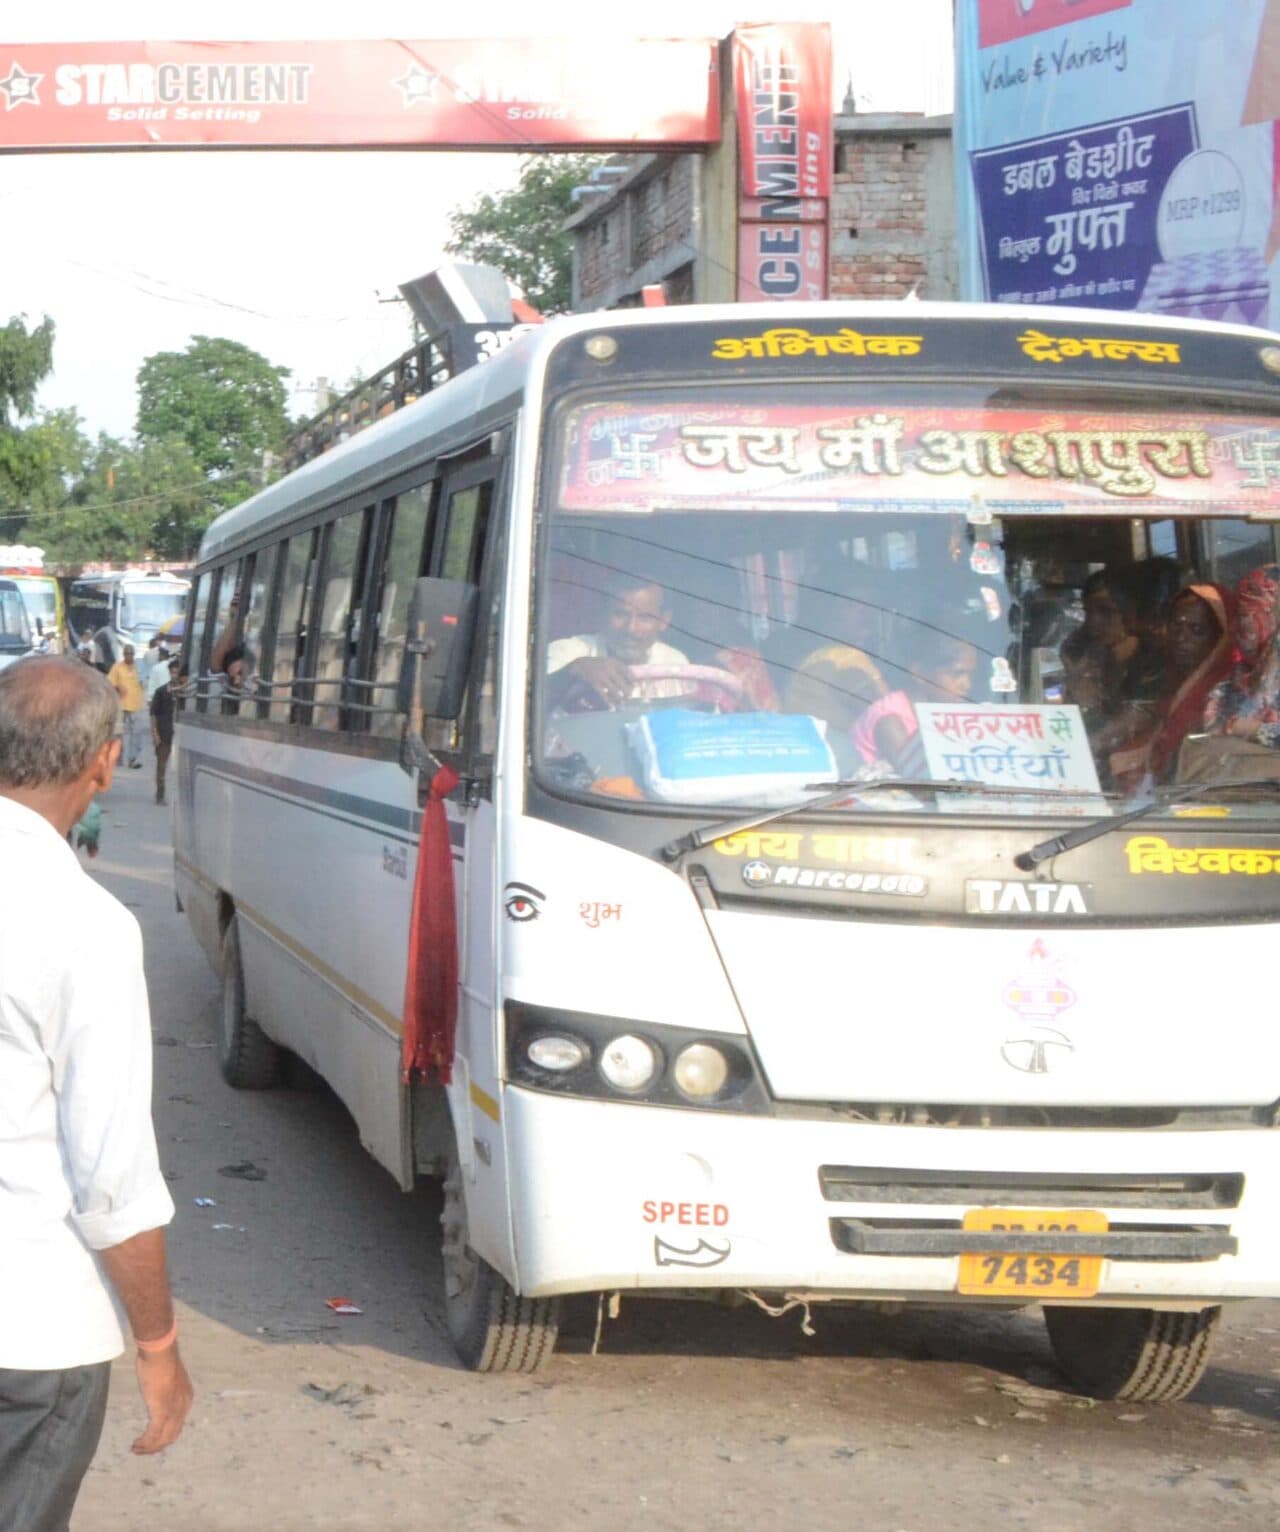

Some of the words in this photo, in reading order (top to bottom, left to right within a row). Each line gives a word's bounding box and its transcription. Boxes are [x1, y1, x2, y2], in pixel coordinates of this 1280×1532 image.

[981, 54, 1028, 92] Value
[1033, 55, 1047, 82] &
[1051, 31, 1128, 74] Variety
[106, 106, 167, 121] Solid
[174, 106, 261, 123] Setting
[754, 50, 802, 296] CEMENT
[1002, 155, 1058, 196] डबल
[1064, 126, 1155, 182] बेडशीट
[1045, 202, 1134, 275] मुफ्त
[711, 327, 923, 360] अभिषेक
[680, 424, 801, 474] जय
[916, 427, 1214, 496] आशापुरा
[931, 712, 1044, 743] सहरसा
[1048, 711, 1073, 742] से
[714, 831, 804, 859] जय
[1125, 836, 1280, 876] विश्वक
[773, 867, 925, 895] Marcopolo
[971, 882, 1089, 913] TATA
[579, 901, 624, 928] शुभ
[642, 1200, 730, 1226] SPEED
[982, 1256, 1080, 1286] 7434
